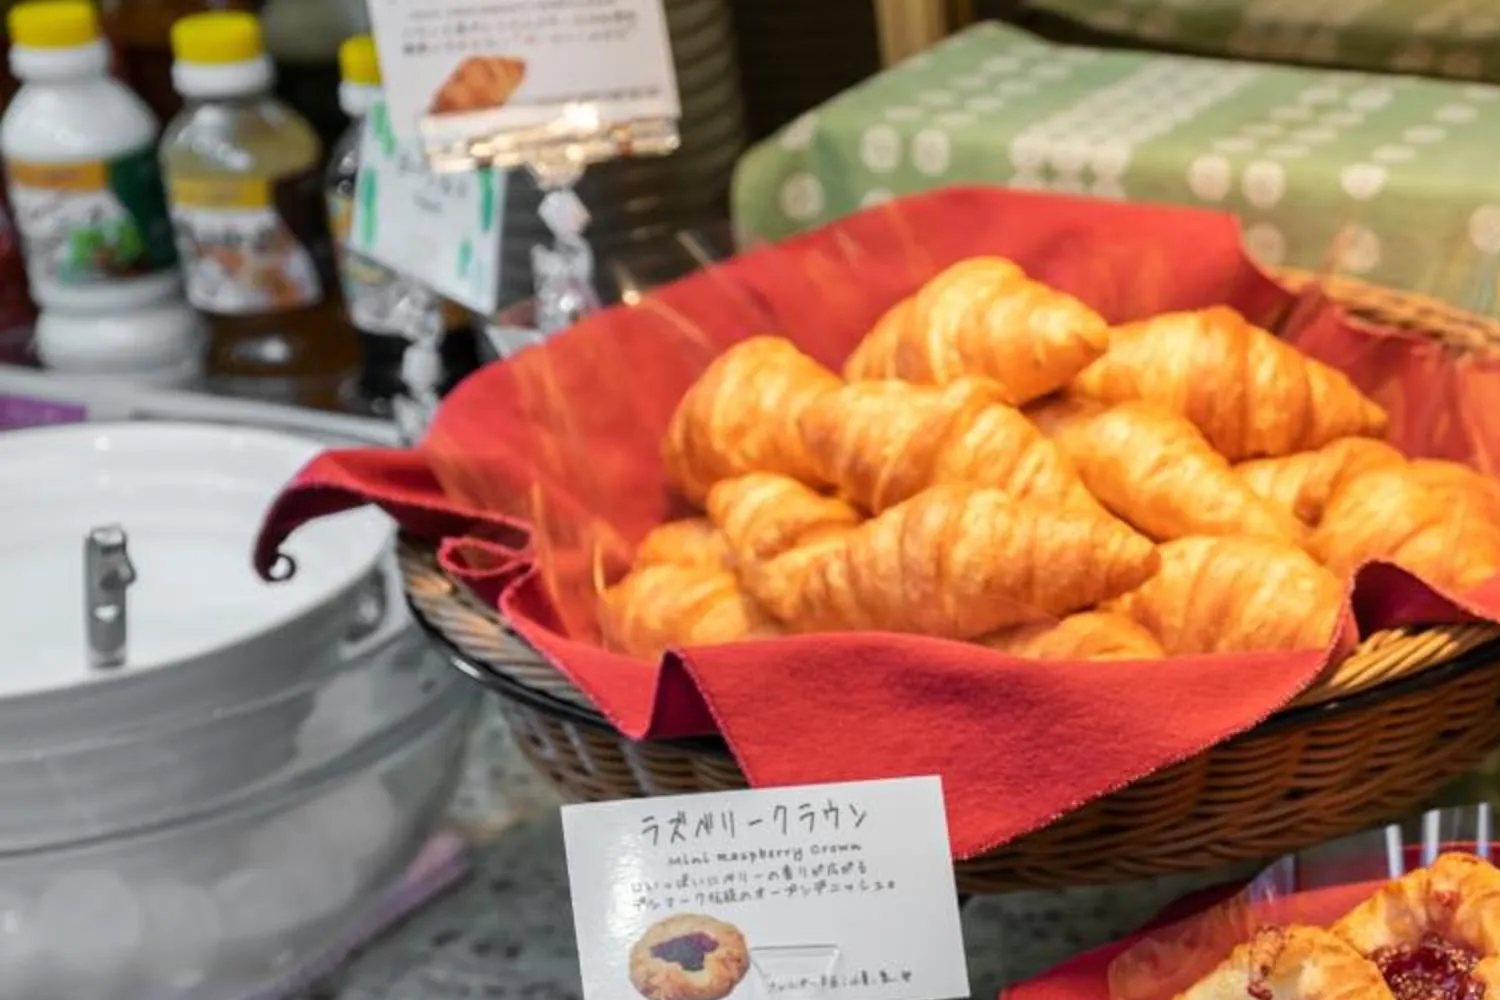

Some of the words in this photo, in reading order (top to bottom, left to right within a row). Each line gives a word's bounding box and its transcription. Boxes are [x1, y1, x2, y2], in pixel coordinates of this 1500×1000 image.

[641, 798, 868, 846] ラズベリークラウン
